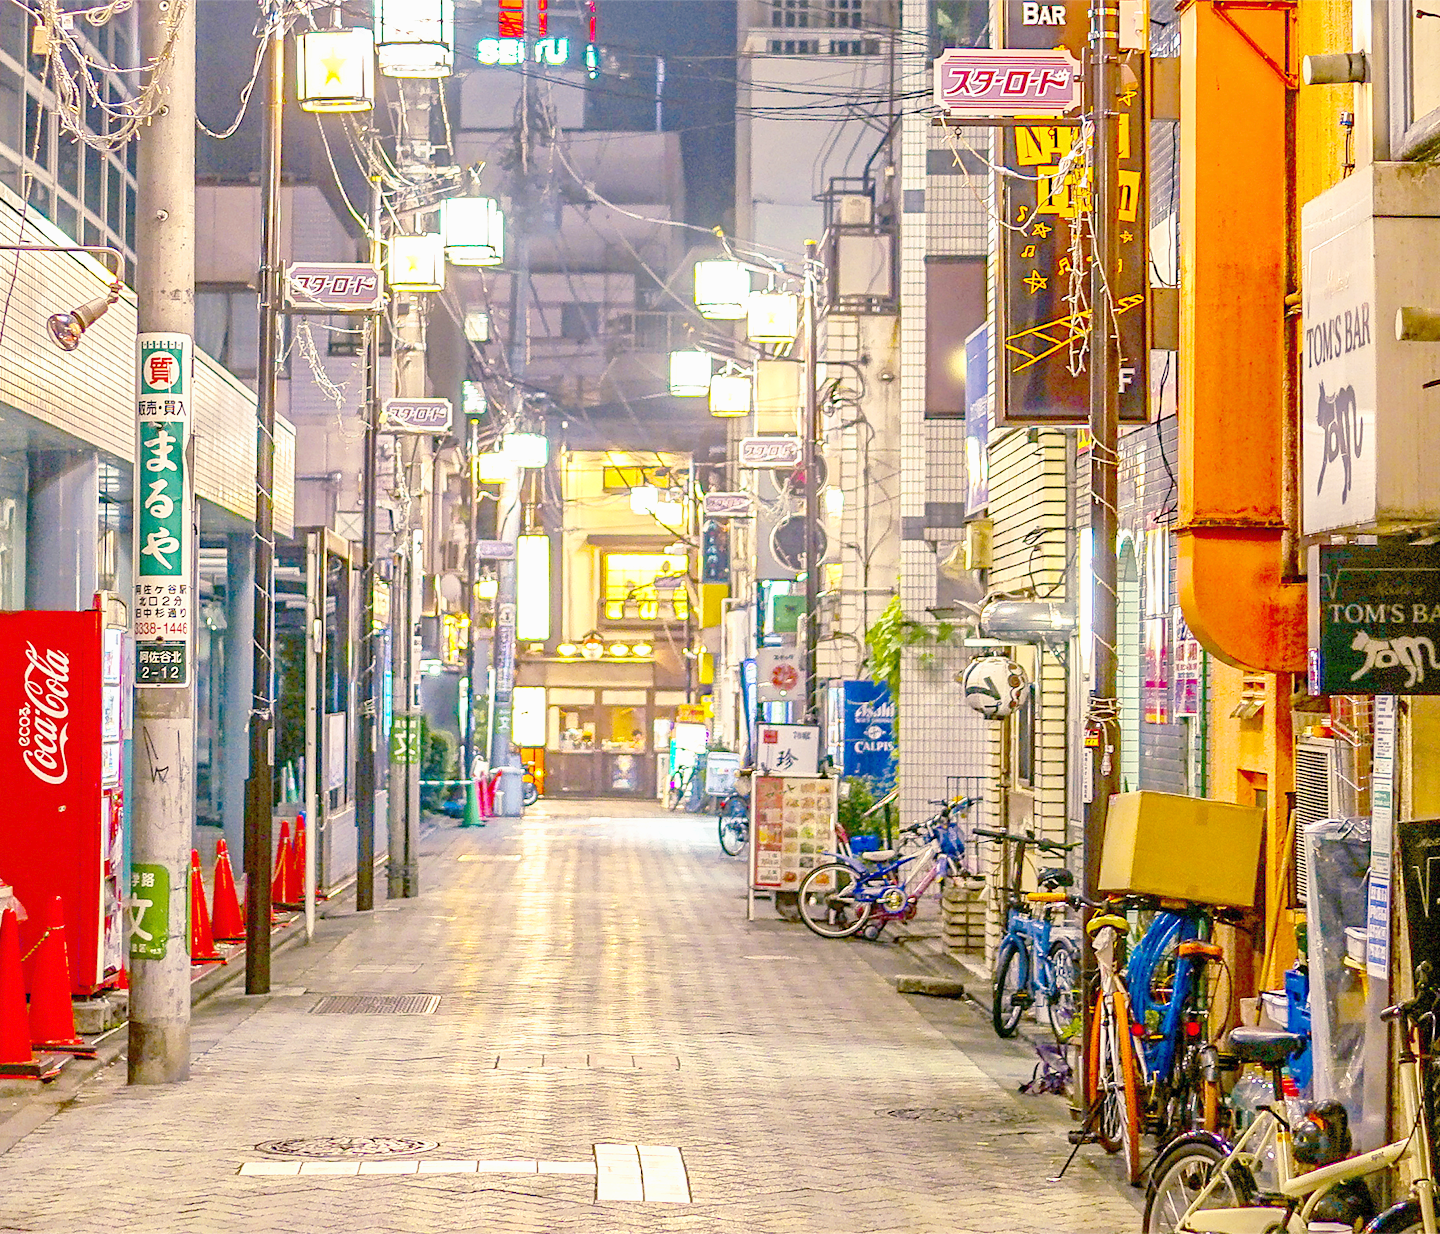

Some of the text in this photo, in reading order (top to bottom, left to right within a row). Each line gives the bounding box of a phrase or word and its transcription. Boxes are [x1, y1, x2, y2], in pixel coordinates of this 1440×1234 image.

[1023, 2, 1067, 25] BAR
[944, 68, 1071, 97] スターロード
[1306, 302, 1371, 368] TOM'S BAR
[149, 357, 173, 385] 質
[141, 428, 181, 570] まるや
[1328, 603, 1405, 624] TOM'S
[139, 651, 182, 663] 阿佐谷北
[141, 666, 180, 679] 2-12
[854, 740, 895, 754] CALPIS
